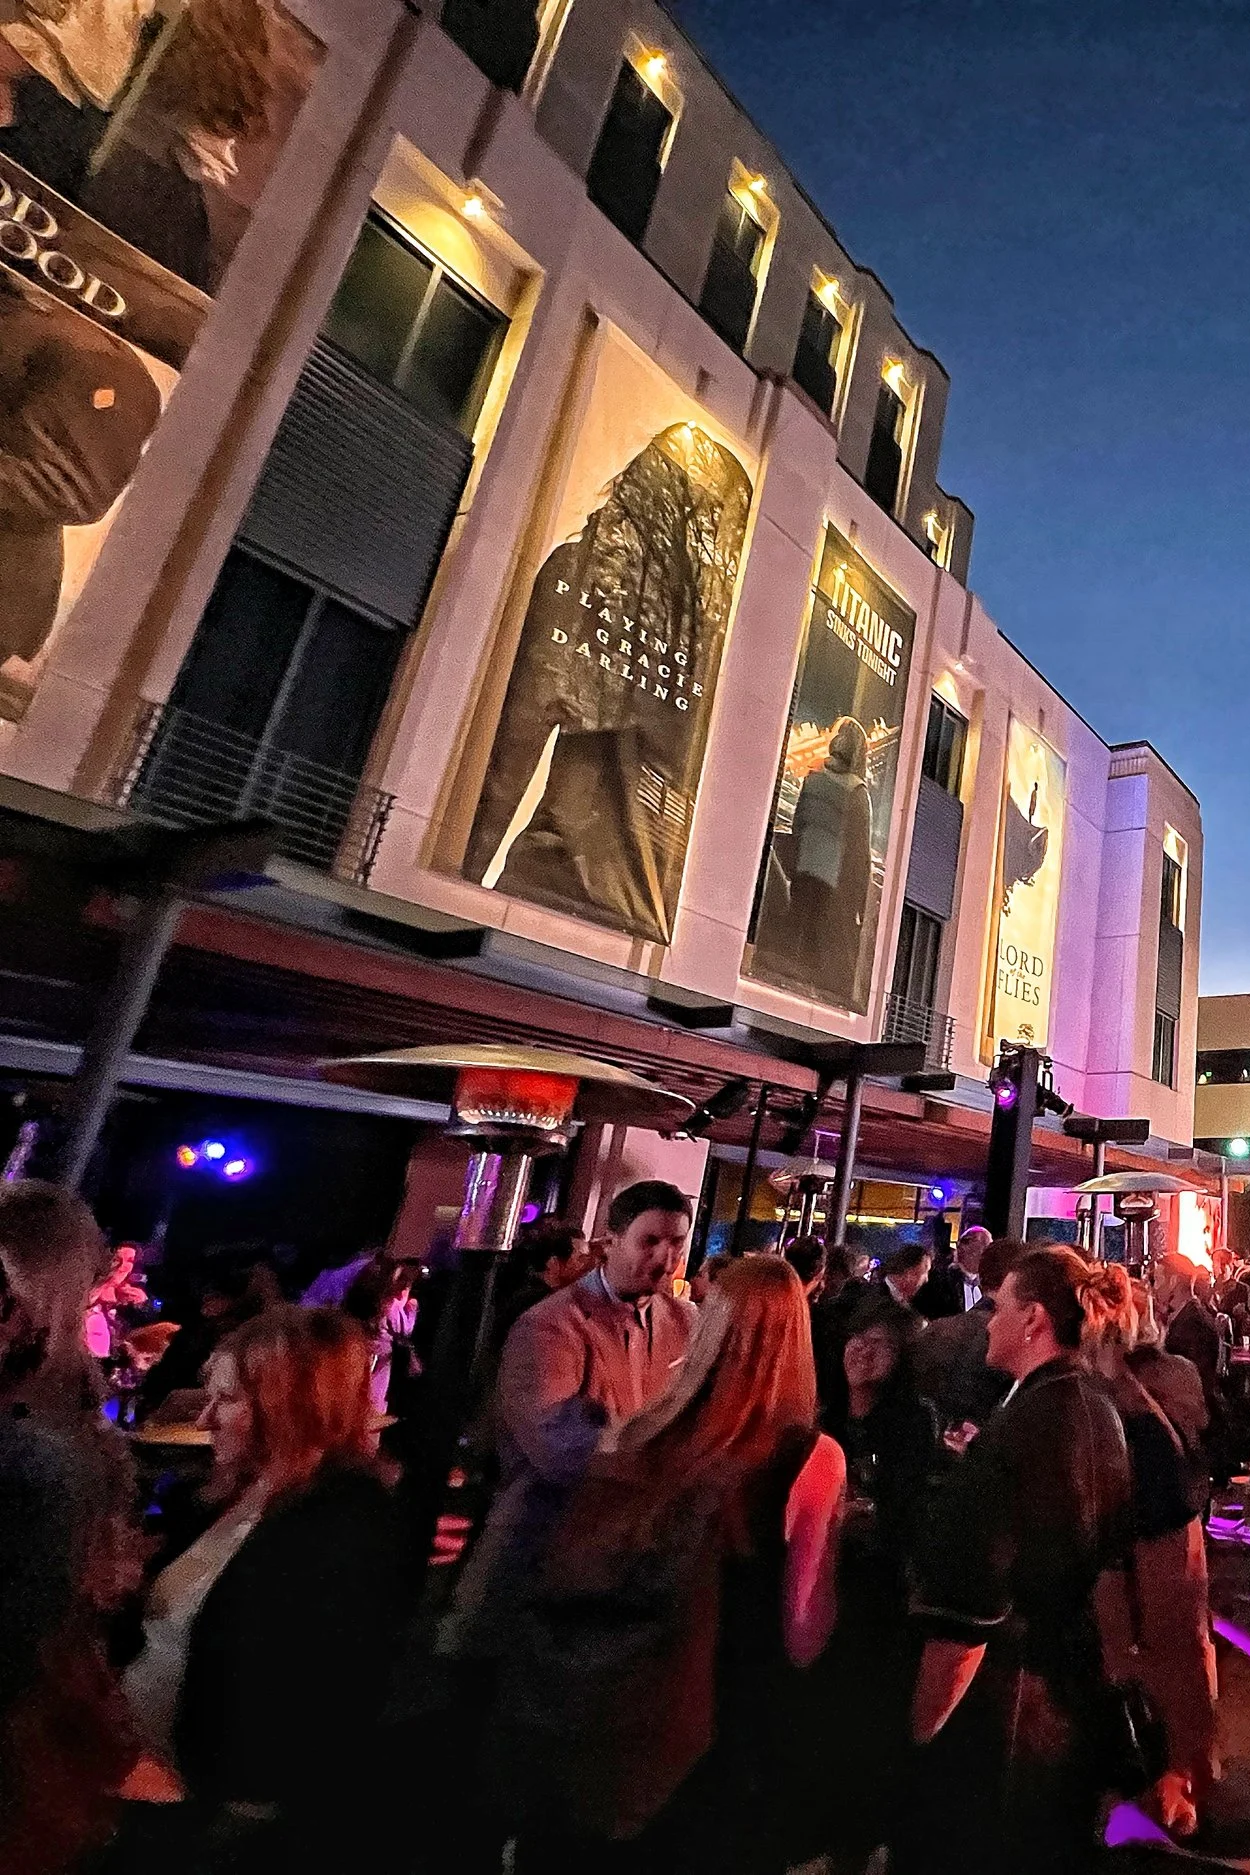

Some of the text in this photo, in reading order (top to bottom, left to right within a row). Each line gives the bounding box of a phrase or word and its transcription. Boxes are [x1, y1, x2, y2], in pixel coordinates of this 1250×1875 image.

[0, 178, 58, 238] D
[555, 579, 688, 666] PLAYING
[826, 608, 897, 686] SINKS TONIGHT
[831, 566, 903, 667] TITANIC
[551, 627, 689, 711] DARLING
[596, 628, 703, 697] GRACIE
[998, 968, 1040, 1006] FLIES
[1000, 938, 1044, 977] LORD
